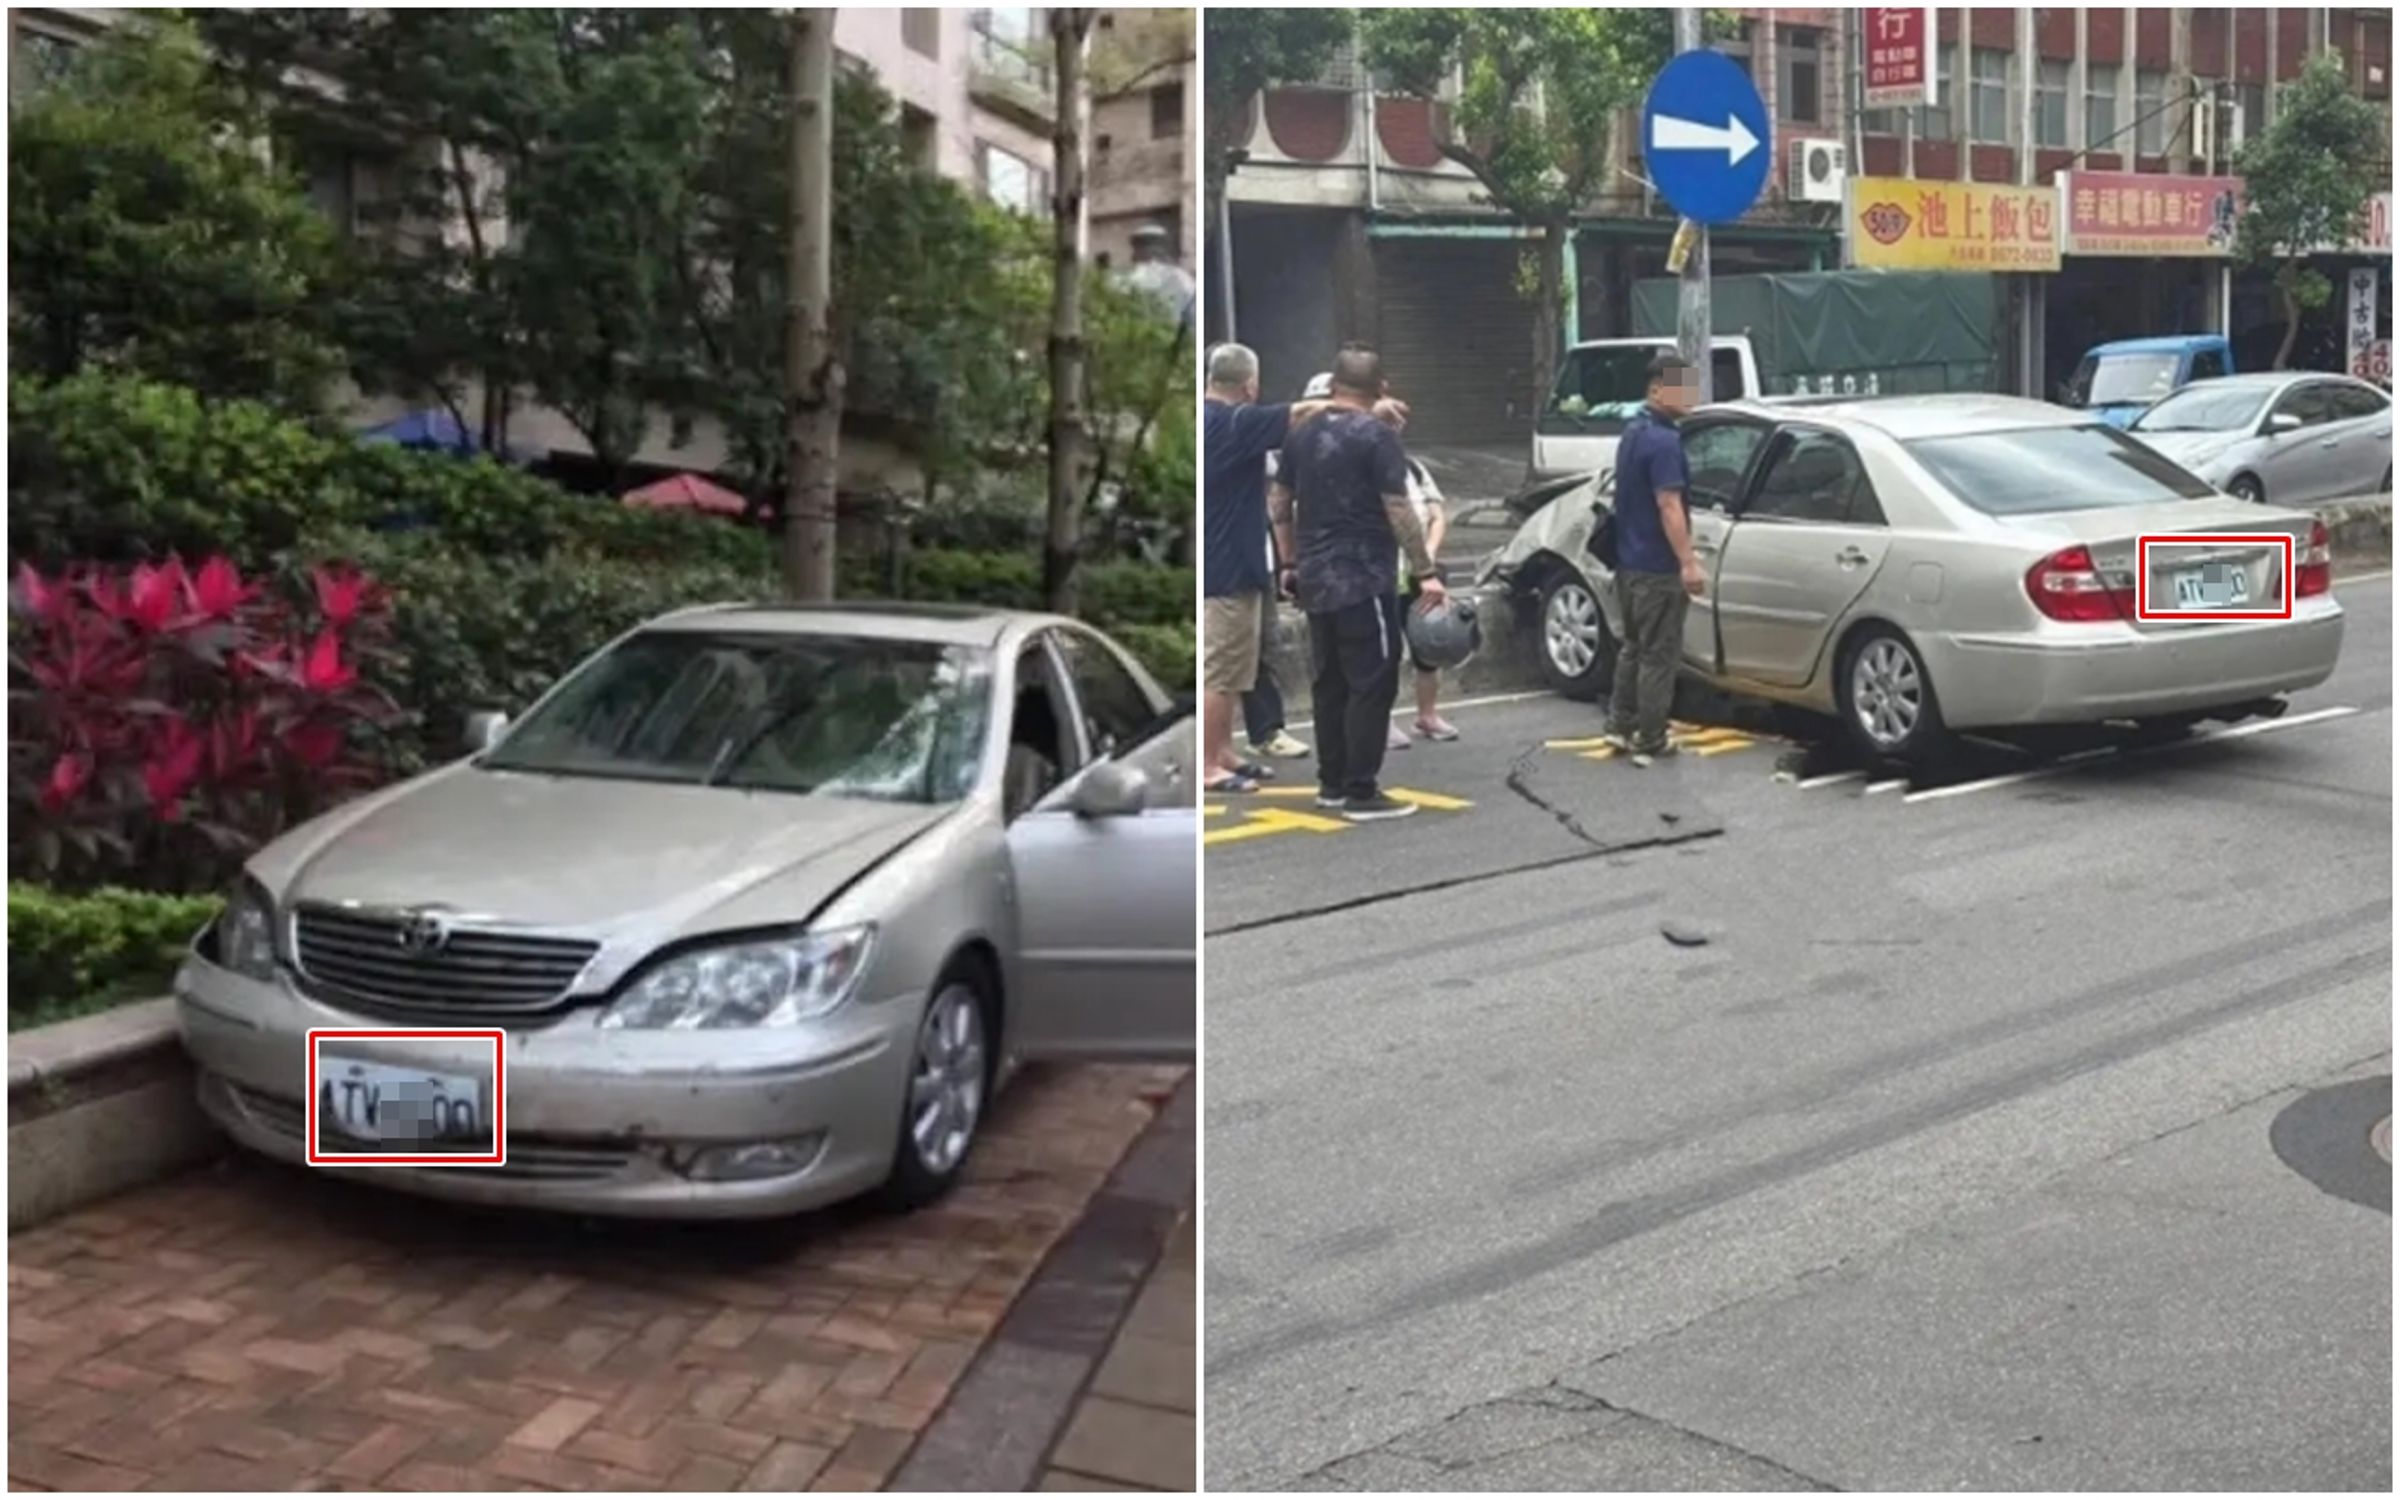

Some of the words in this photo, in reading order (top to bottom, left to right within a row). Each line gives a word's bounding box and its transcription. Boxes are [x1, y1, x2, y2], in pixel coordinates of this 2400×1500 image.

[1916, 190, 2053, 242] 池上飯包
[2076, 188, 2203, 228] 幸福電動車行
